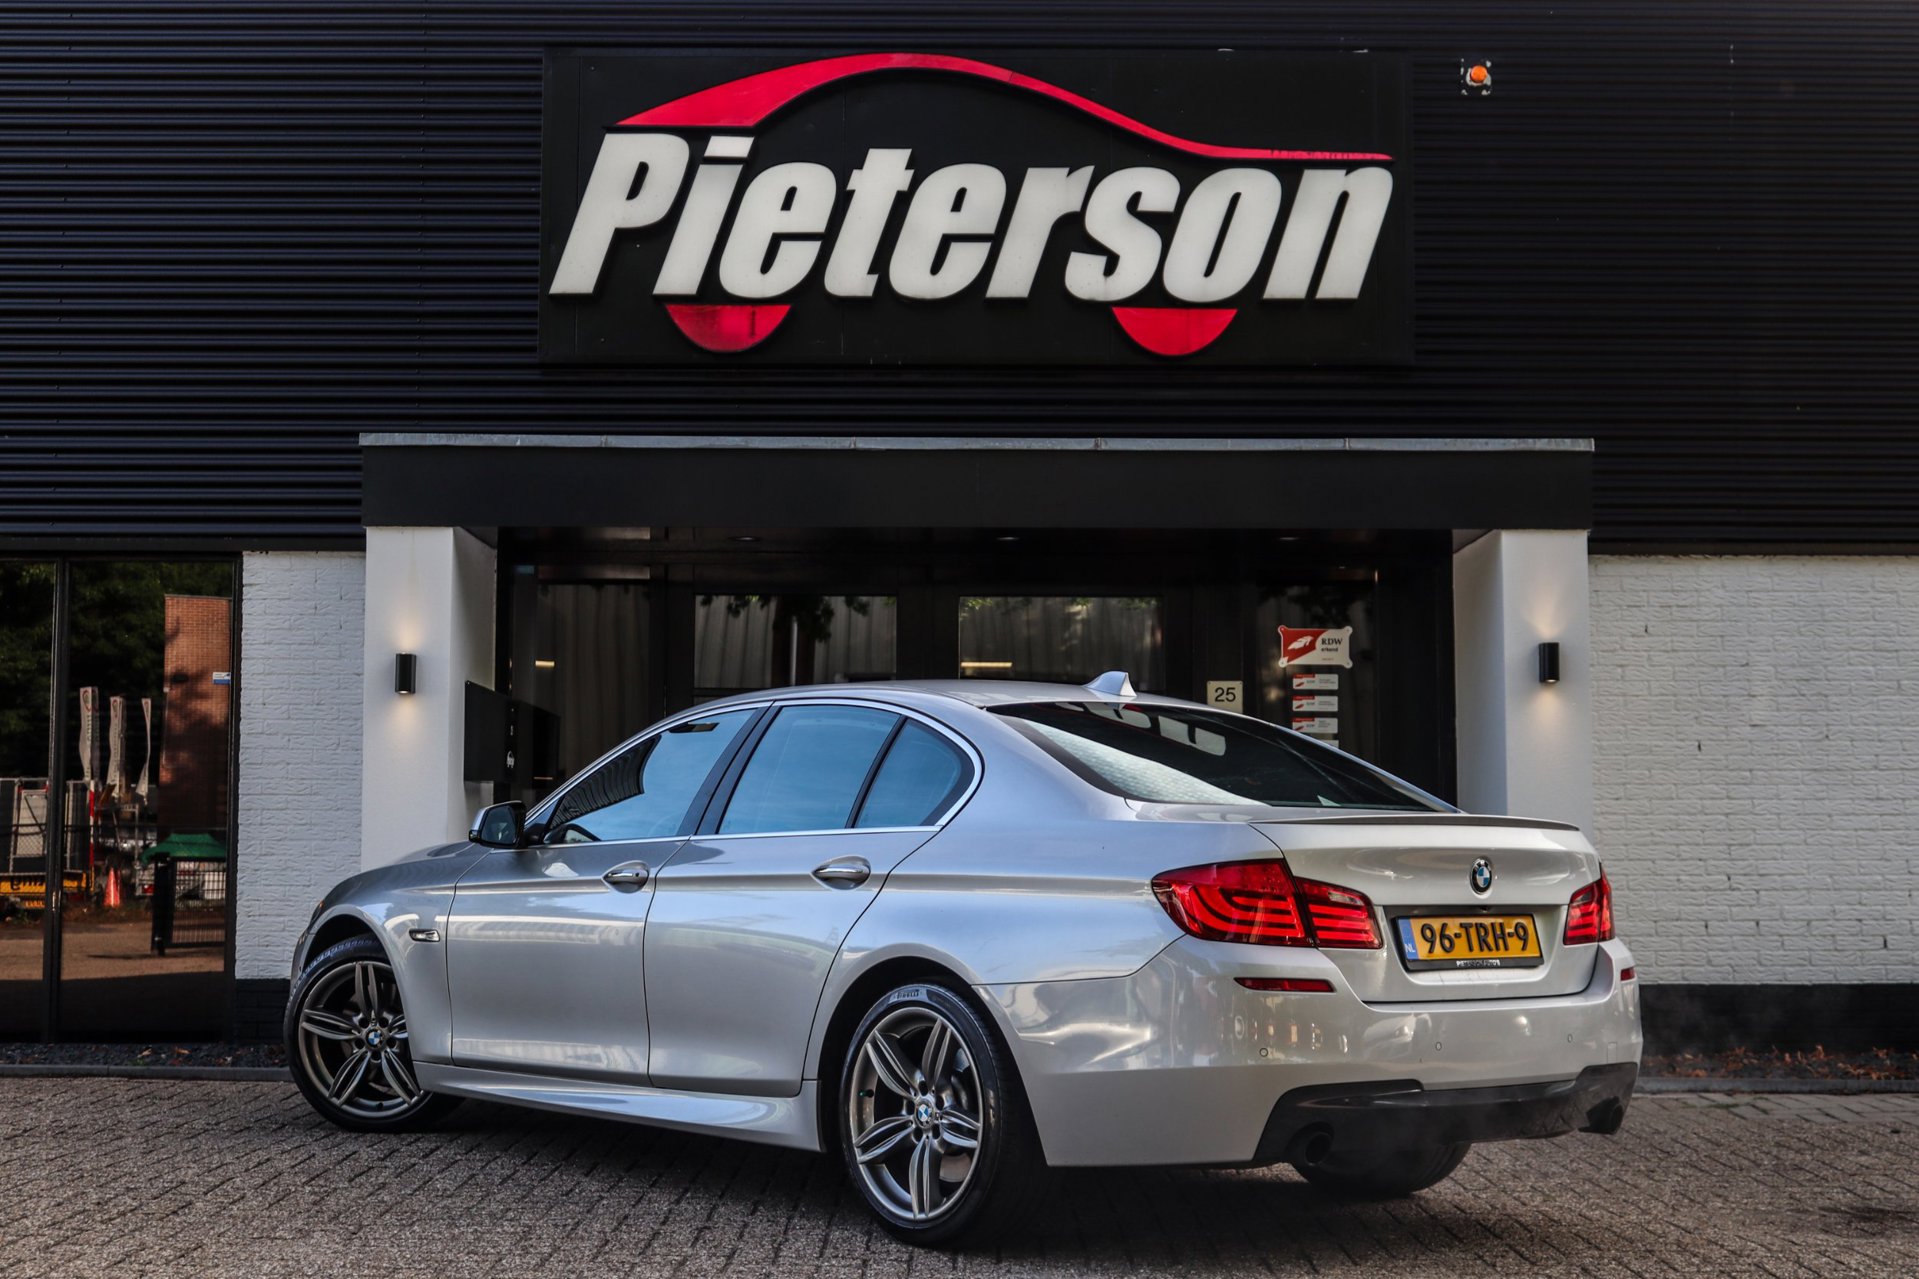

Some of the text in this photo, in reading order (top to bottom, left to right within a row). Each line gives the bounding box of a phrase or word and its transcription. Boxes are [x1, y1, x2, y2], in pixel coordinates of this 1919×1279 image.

[548, 132, 1395, 303] Pieterson
[1321, 637, 1343, 646] RDW
[1214, 687, 1236, 703] 25
[1420, 922, 1529, 954] 96-TRH-9
[1405, 943, 1416, 954] NL
